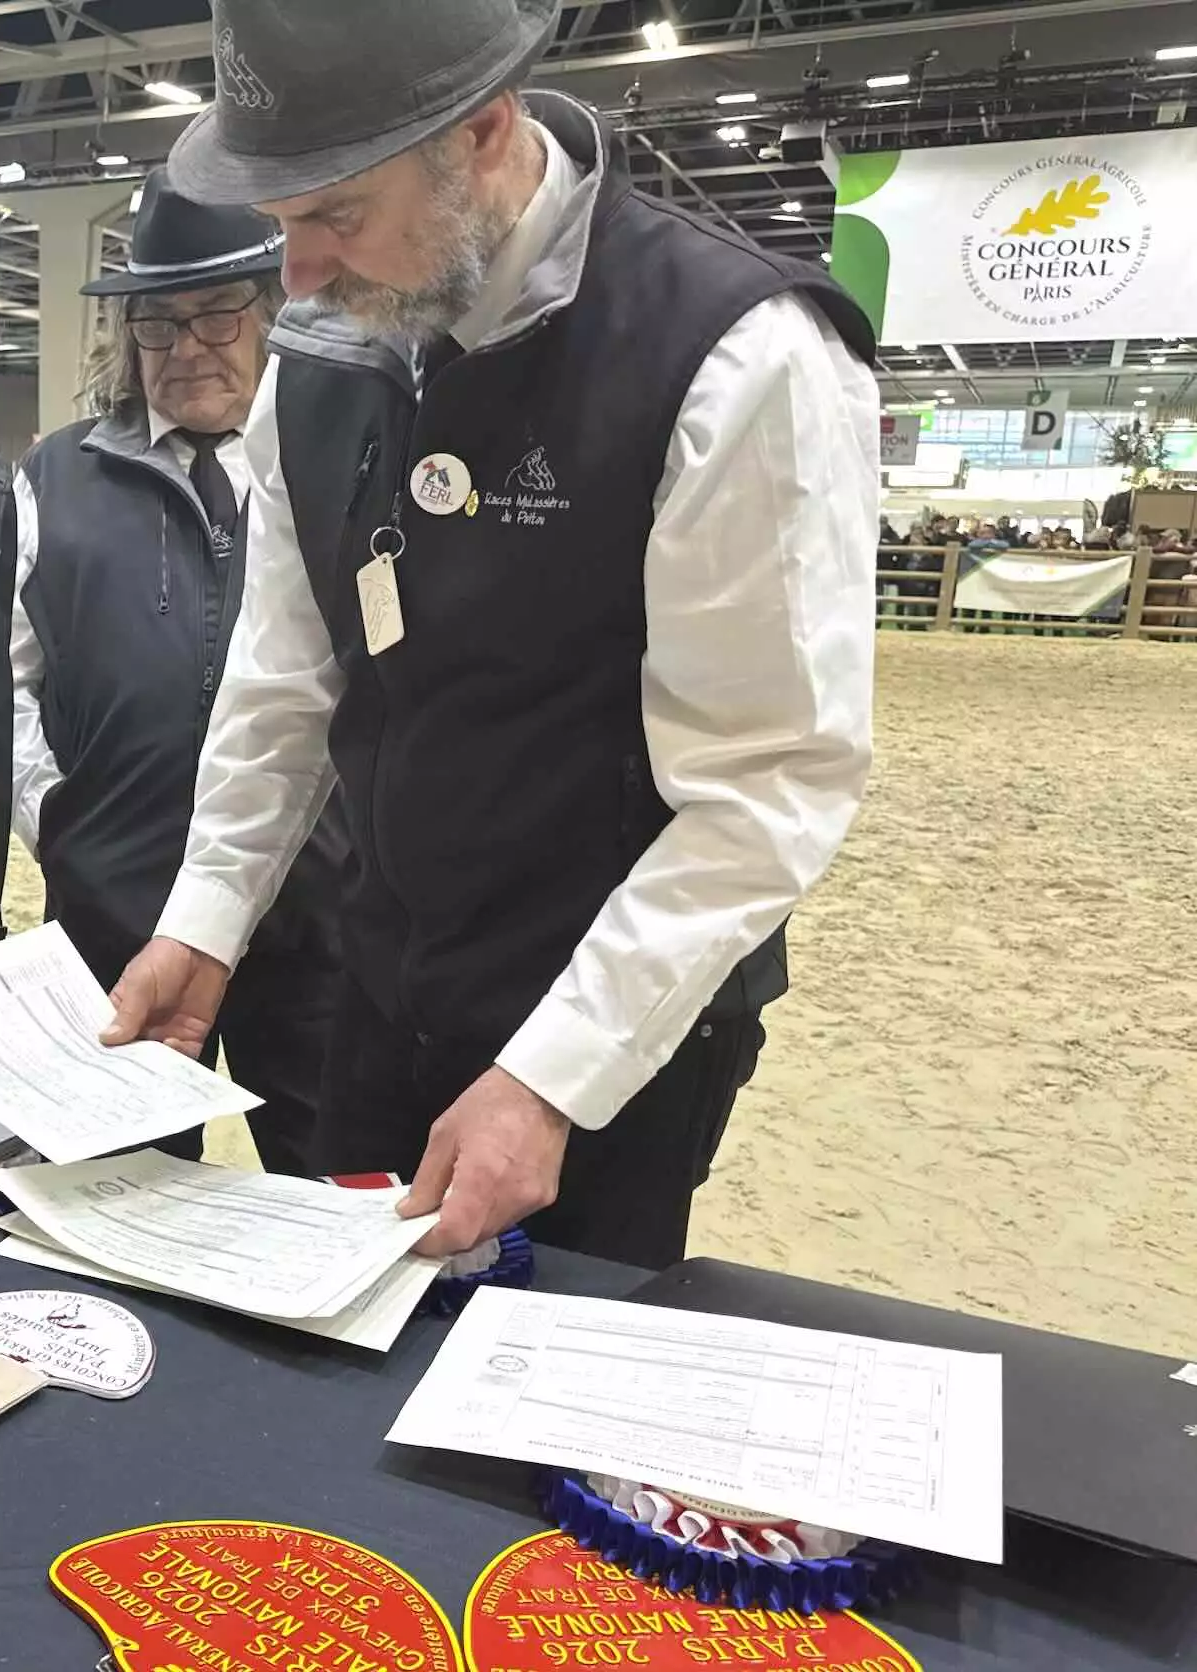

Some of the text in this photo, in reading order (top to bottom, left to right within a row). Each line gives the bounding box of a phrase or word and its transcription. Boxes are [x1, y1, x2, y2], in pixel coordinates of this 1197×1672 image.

[978, 236, 1131, 260] CONCOURS
[989, 257, 1113, 281] GÉNÉRAL
[1023, 281, 1072, 303] PARIS
[1062, 311, 1080, 323] DE
[1032, 411, 1057, 435] D
[484, 492, 512, 506] Races
[501, 510, 546, 526] du Poitou
[42, 1343, 106, 1369] PARIS
[74, 1336, 111, 1357] Jury
[55, 1358, 127, 1388] CONCOURS
[310, 1539, 336, 1554] de
[342, 1551, 406, 1592] charge
[67, 1556, 172, 1631] AGRICOLE
[134, 1571, 228, 1628] 2026
[139, 1541, 305, 1638] NATIONALE
[516, 1587, 600, 1609] TRAIT
[596, 1586, 637, 1602] DE
[195, 1541, 426, 1671] CHEVAUX DE TRAIT
[404, 1593, 426, 1614] en
[497, 1607, 827, 1639] FINALE NATIONALE
[542, 1634, 827, 1666] PARIS 2026
